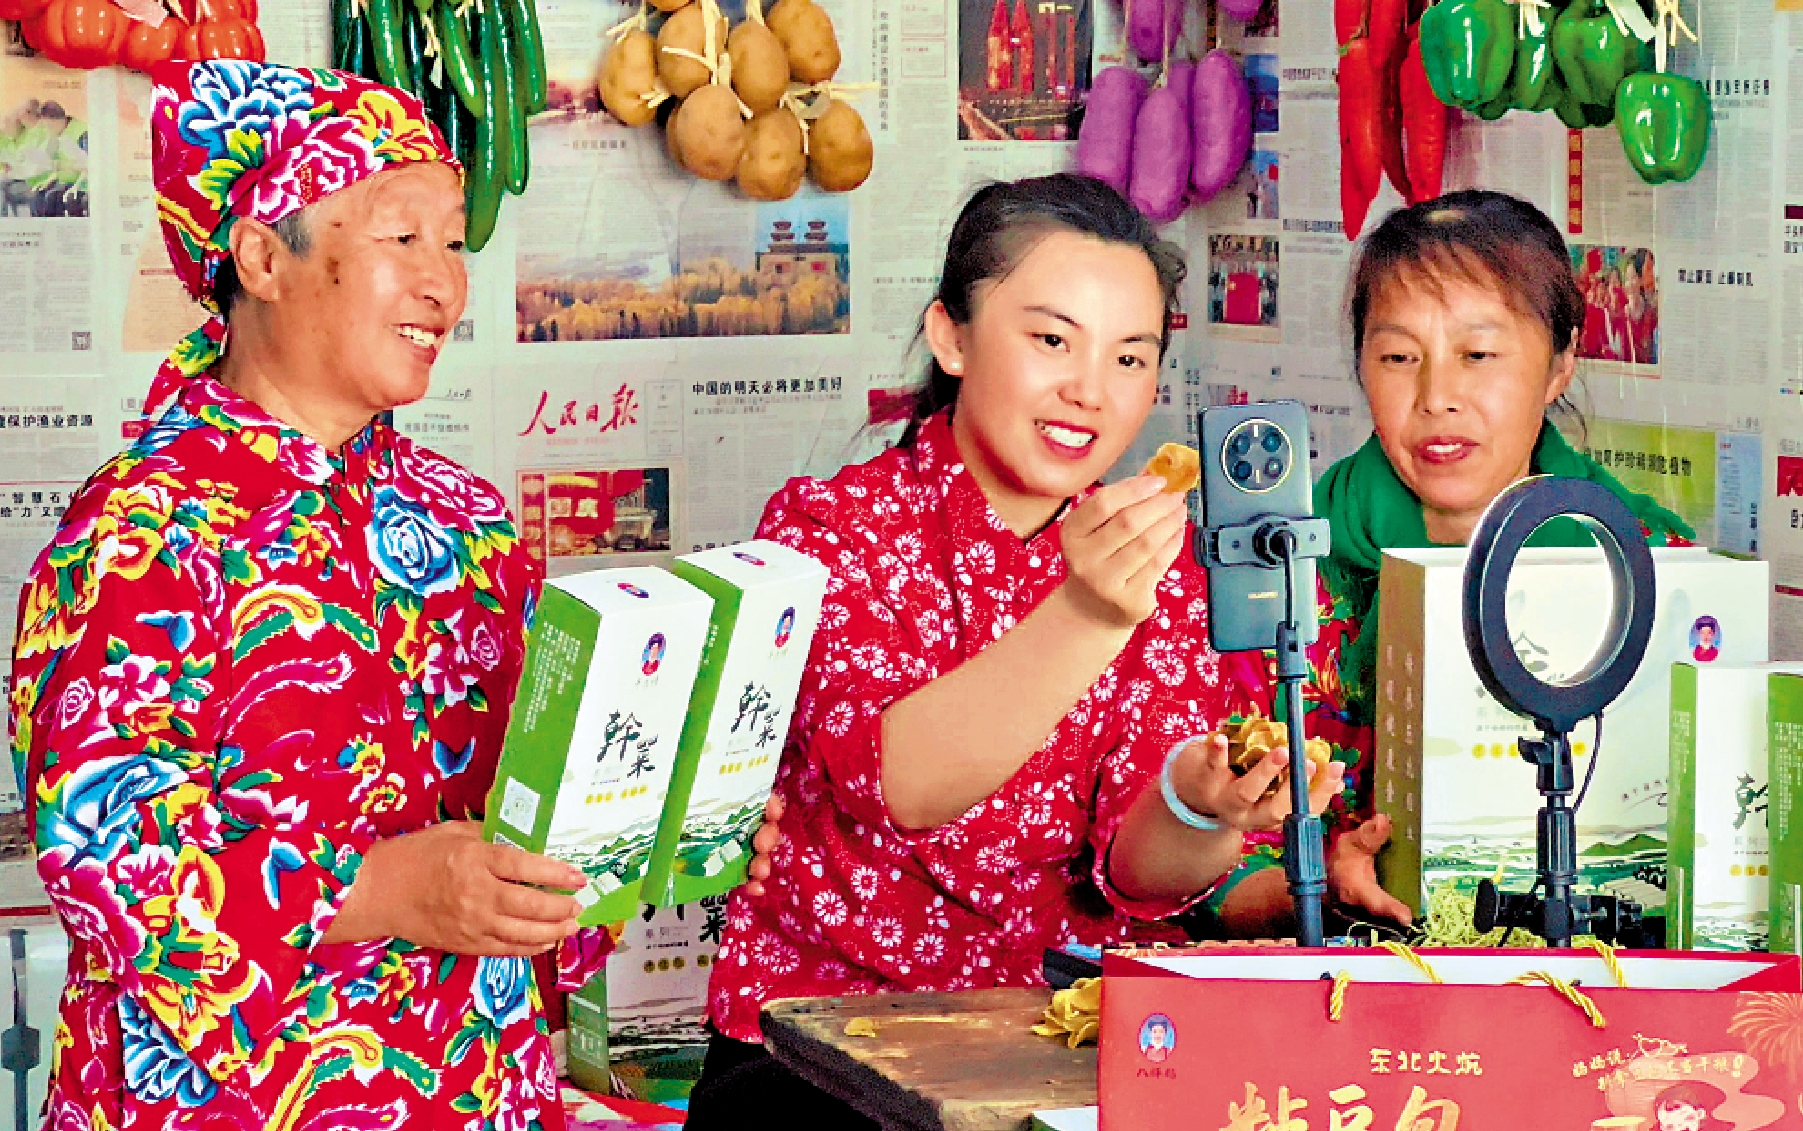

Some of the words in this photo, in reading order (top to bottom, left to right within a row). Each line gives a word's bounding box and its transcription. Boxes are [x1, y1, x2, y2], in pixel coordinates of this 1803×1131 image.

[692, 376, 843, 396] 中国的明天必将更加美好
[517, 383, 639, 437] 人民日报
[1369, 1047, 1483, 1076] 东北火炕
